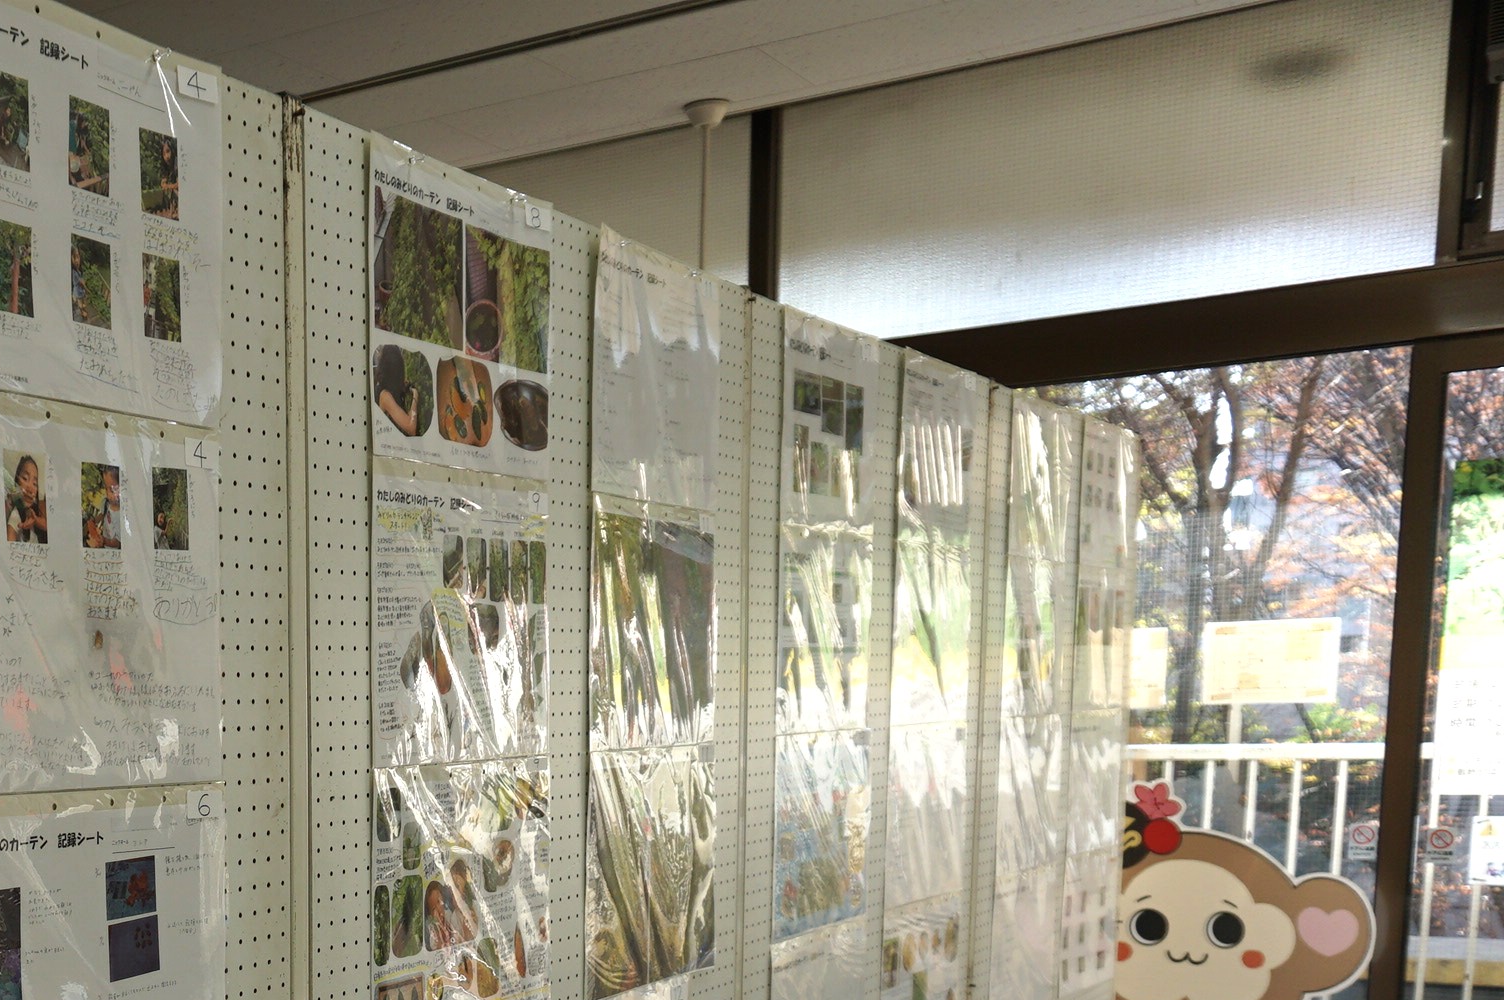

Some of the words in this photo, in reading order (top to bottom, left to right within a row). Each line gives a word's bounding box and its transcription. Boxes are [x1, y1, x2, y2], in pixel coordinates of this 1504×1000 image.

[40, 38, 89, 70] 記録シート
[186, 71, 207, 98] 4
[373, 168, 441, 206] わたしのみどりのカーテン
[530, 207, 543, 229] 8
[192, 440, 207, 468] 4
[377, 488, 445, 509] わたしのみどりのカーテン
[531, 491, 541, 512] 9
[196, 793, 212, 817] 6
[57, 831, 105, 850] 記録シート
